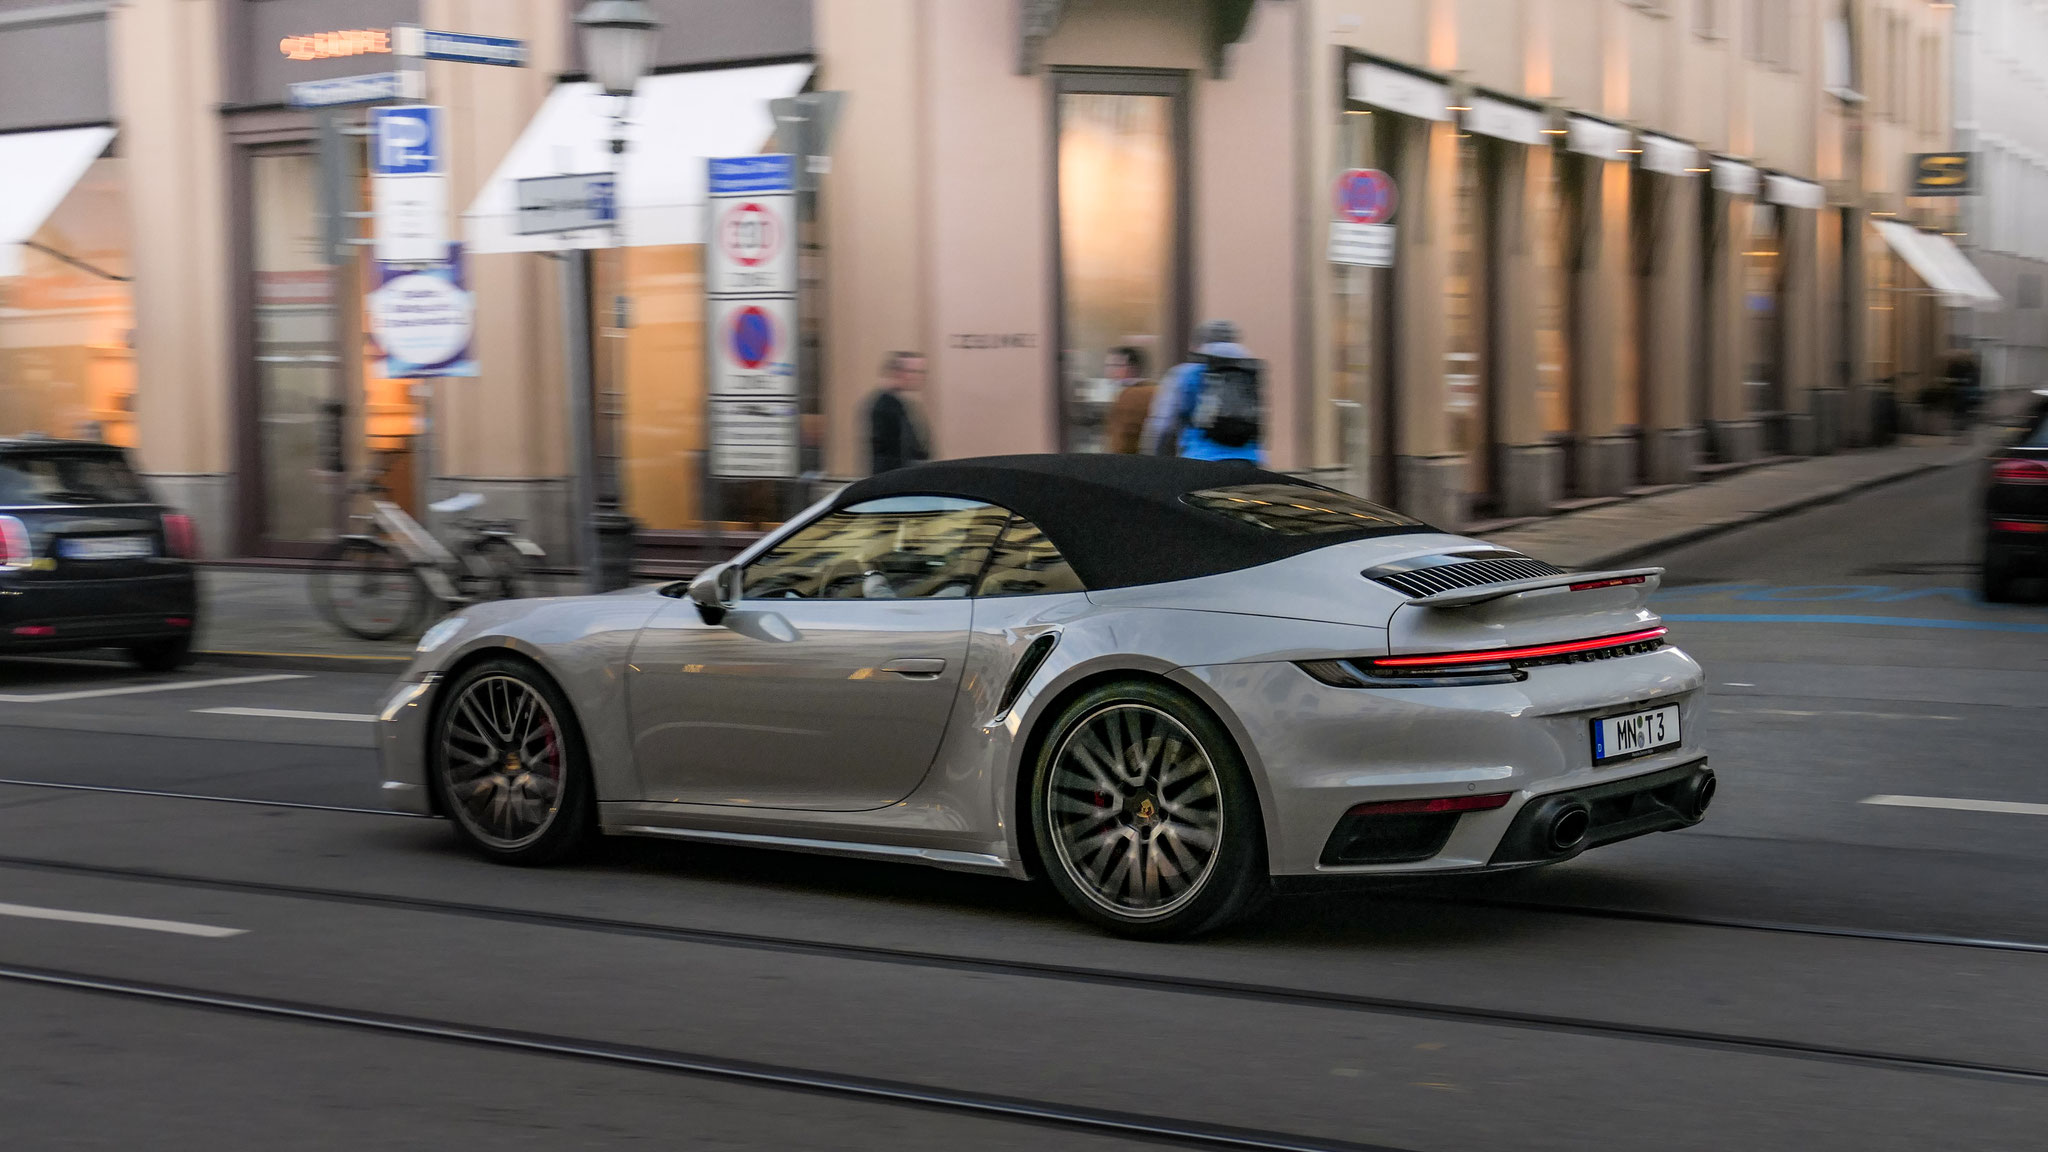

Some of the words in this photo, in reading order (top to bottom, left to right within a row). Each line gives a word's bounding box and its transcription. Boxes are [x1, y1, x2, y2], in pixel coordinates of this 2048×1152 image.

[1617, 718, 1637, 750] MN
[1645, 714, 1653, 744] T
[1657, 712, 1664, 741] 3
